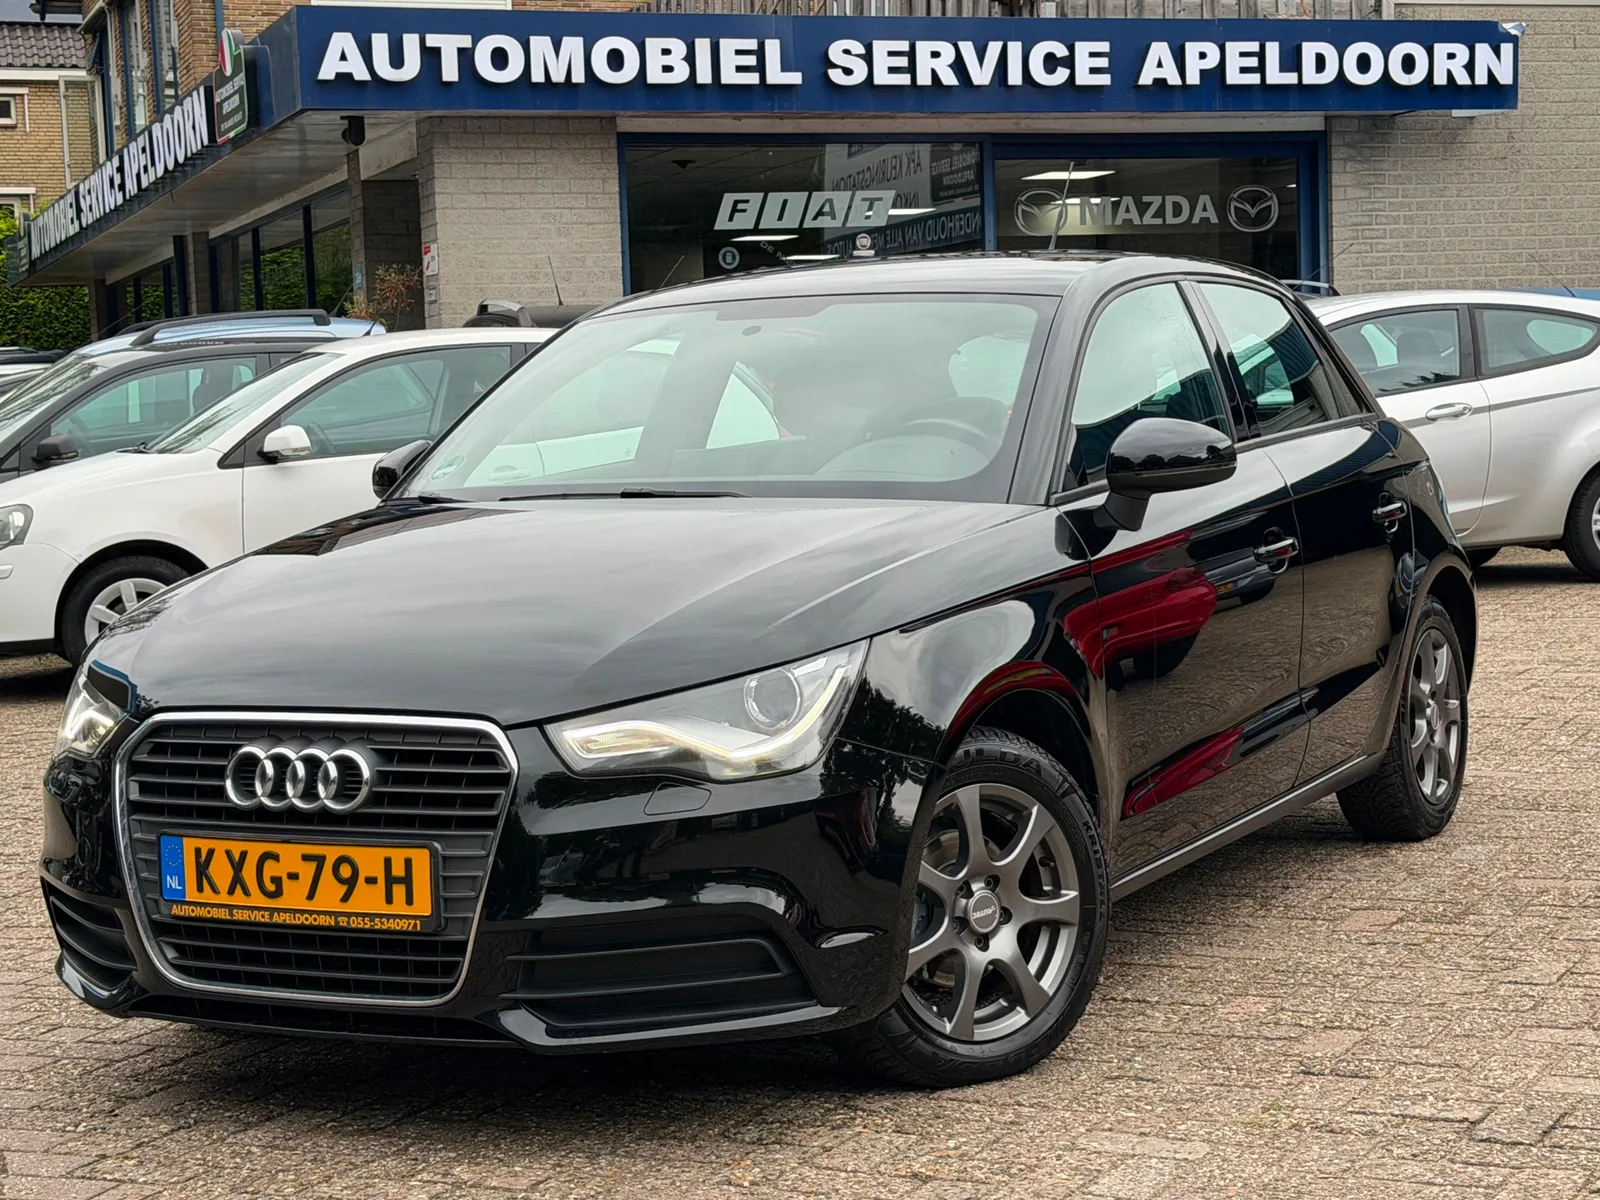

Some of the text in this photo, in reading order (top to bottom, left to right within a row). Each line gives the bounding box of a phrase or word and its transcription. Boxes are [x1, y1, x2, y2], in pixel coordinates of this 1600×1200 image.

[316, 31, 1514, 87] AUTOMOBIEL SERVICE APELDOORN
[30, 189, 81, 260] AUTOMOBIEL
[79, 154, 124, 228] SERVICE
[122, 85, 209, 200] APELDOORN
[721, 193, 889, 226] FIAT
[1079, 194, 1219, 226] MAZDA
[166, 874, 183, 890] NL
[193, 846, 414, 906] KXG-79-H
[170, 904, 421, 932] AUTOMOBIEL SERVICE APELDOORN 055-5340971
